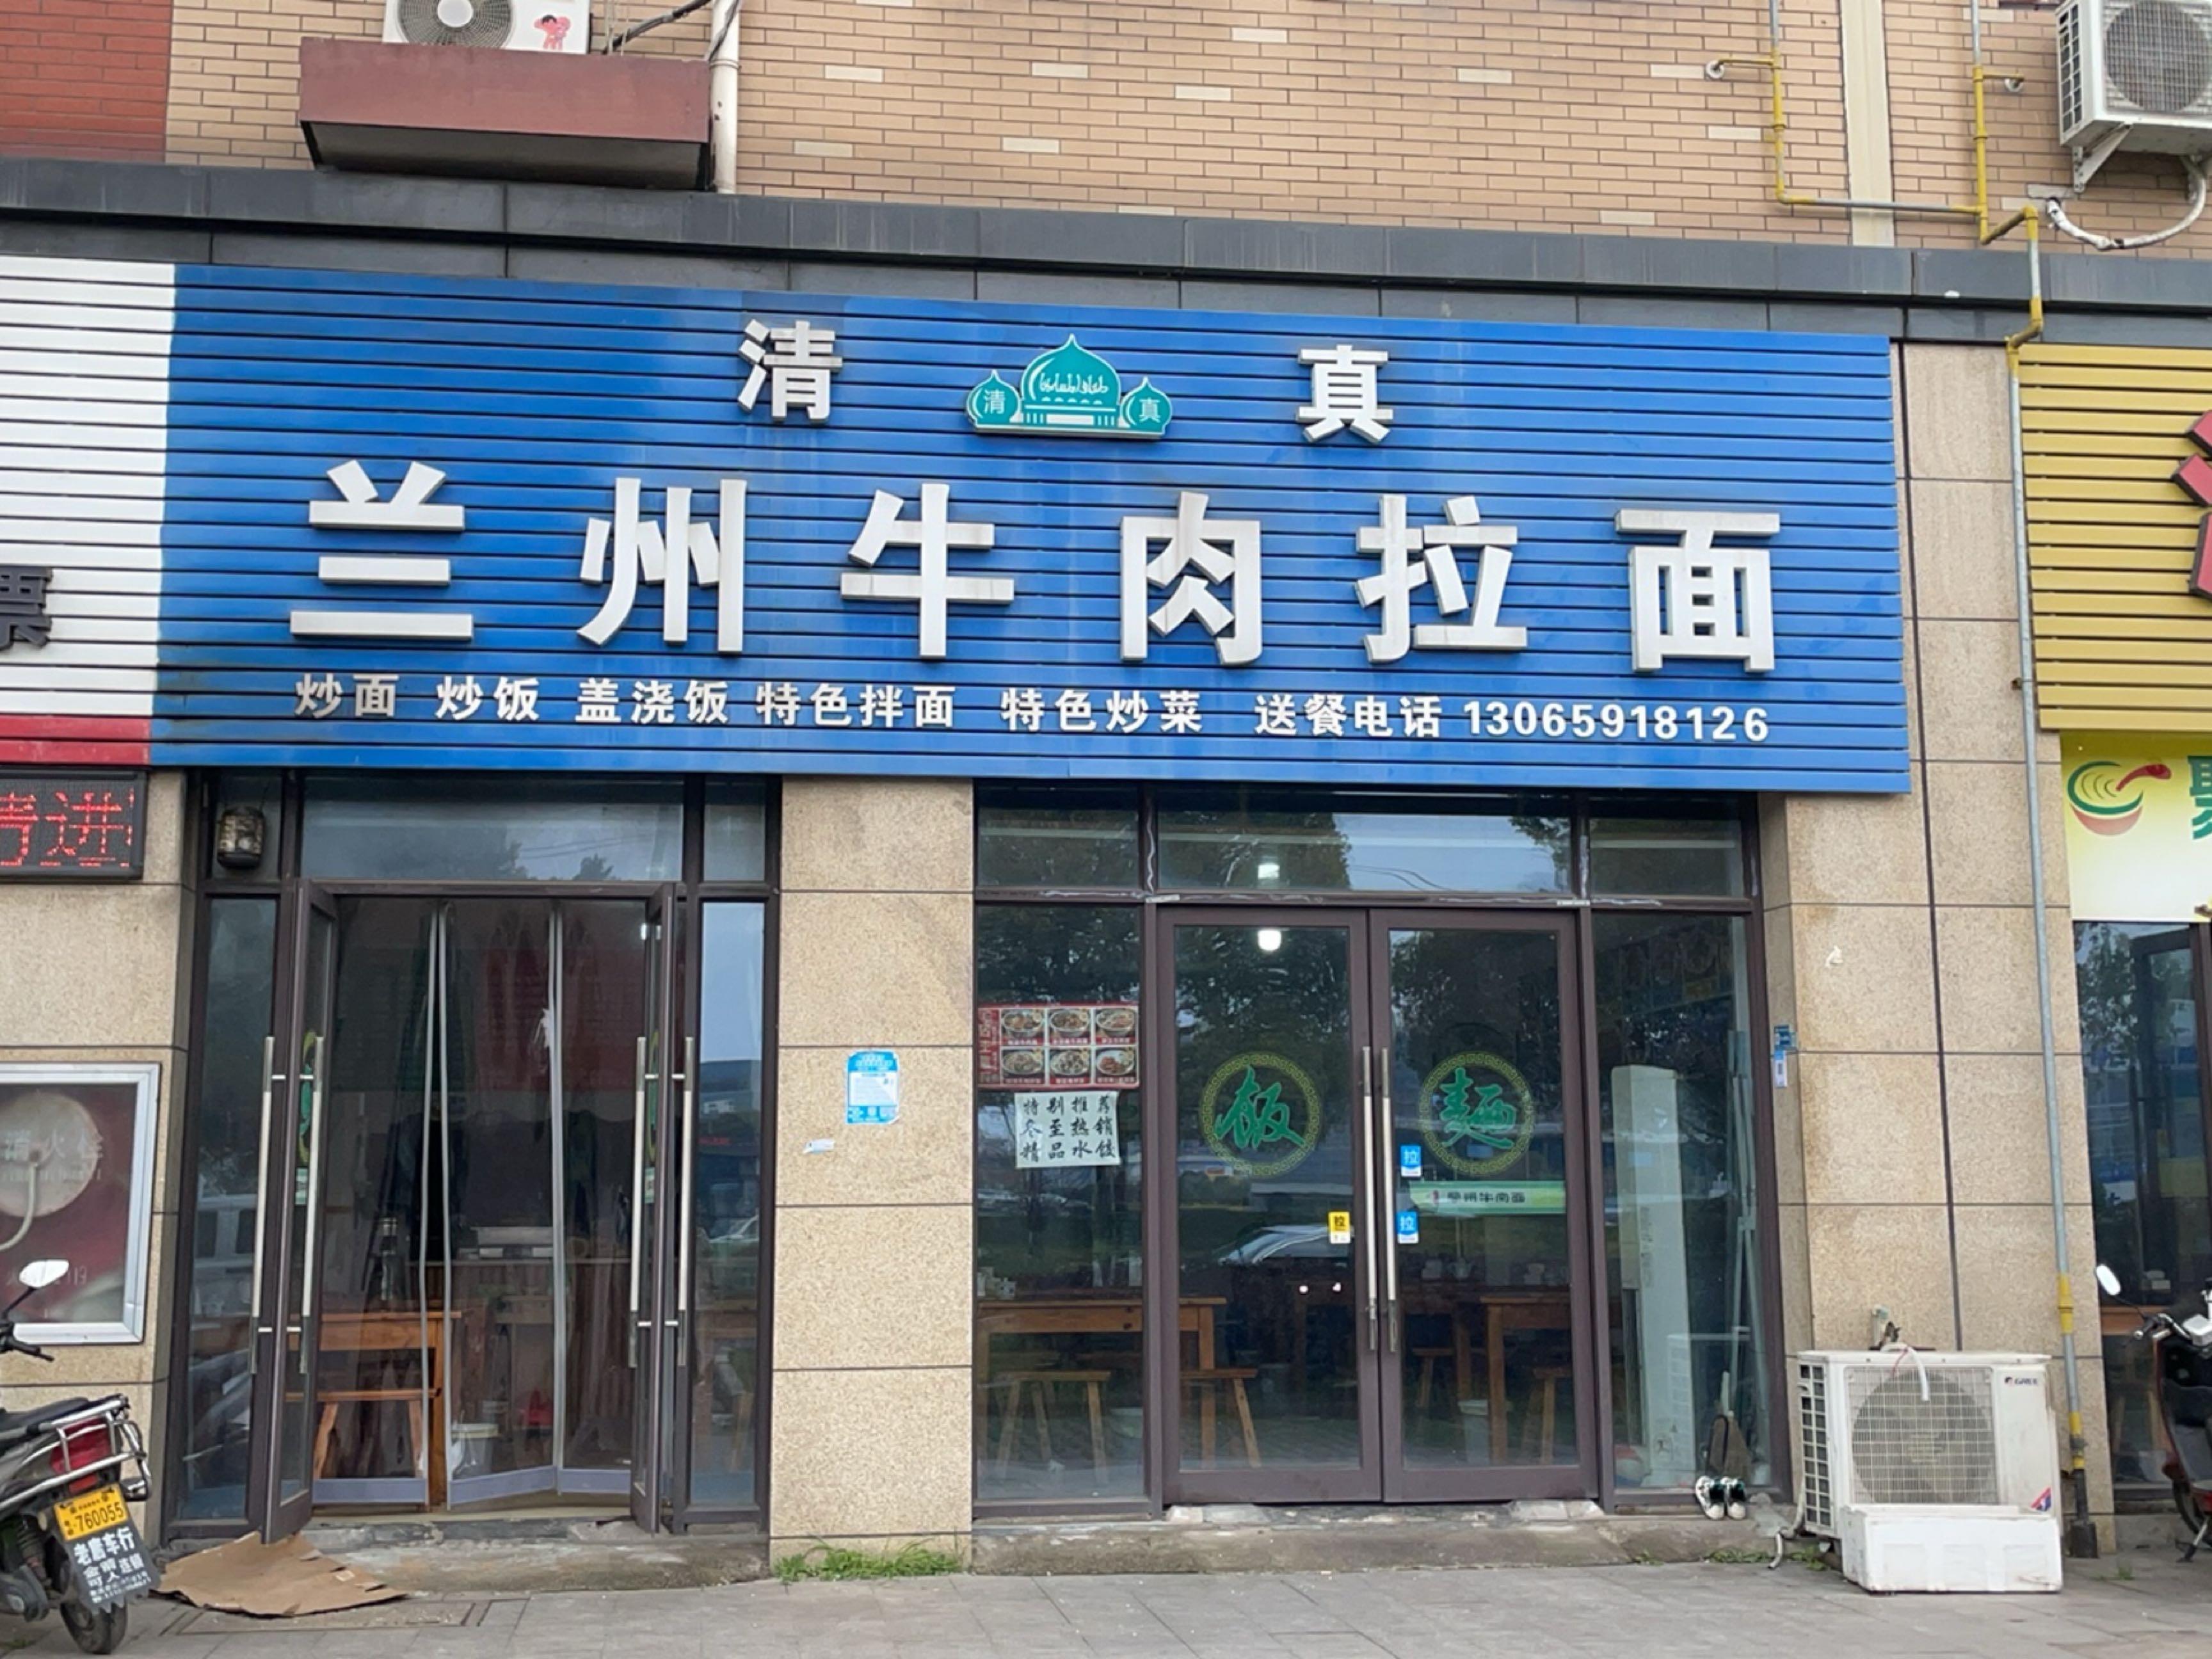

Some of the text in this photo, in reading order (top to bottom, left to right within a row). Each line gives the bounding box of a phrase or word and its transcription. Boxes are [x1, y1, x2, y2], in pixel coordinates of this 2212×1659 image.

[738, 319, 1393, 444] 清 真
[982, 389, 1160, 423] 清 真
[290, 460, 1780, 672] 兰州牛肉拉面
[294, 673, 1768, 742] 炒面 炒饭 盖浇饭 特色拌面 特色炒菜 送餐电话 13065918126
[74, 1502, 125, 1532] 760055
